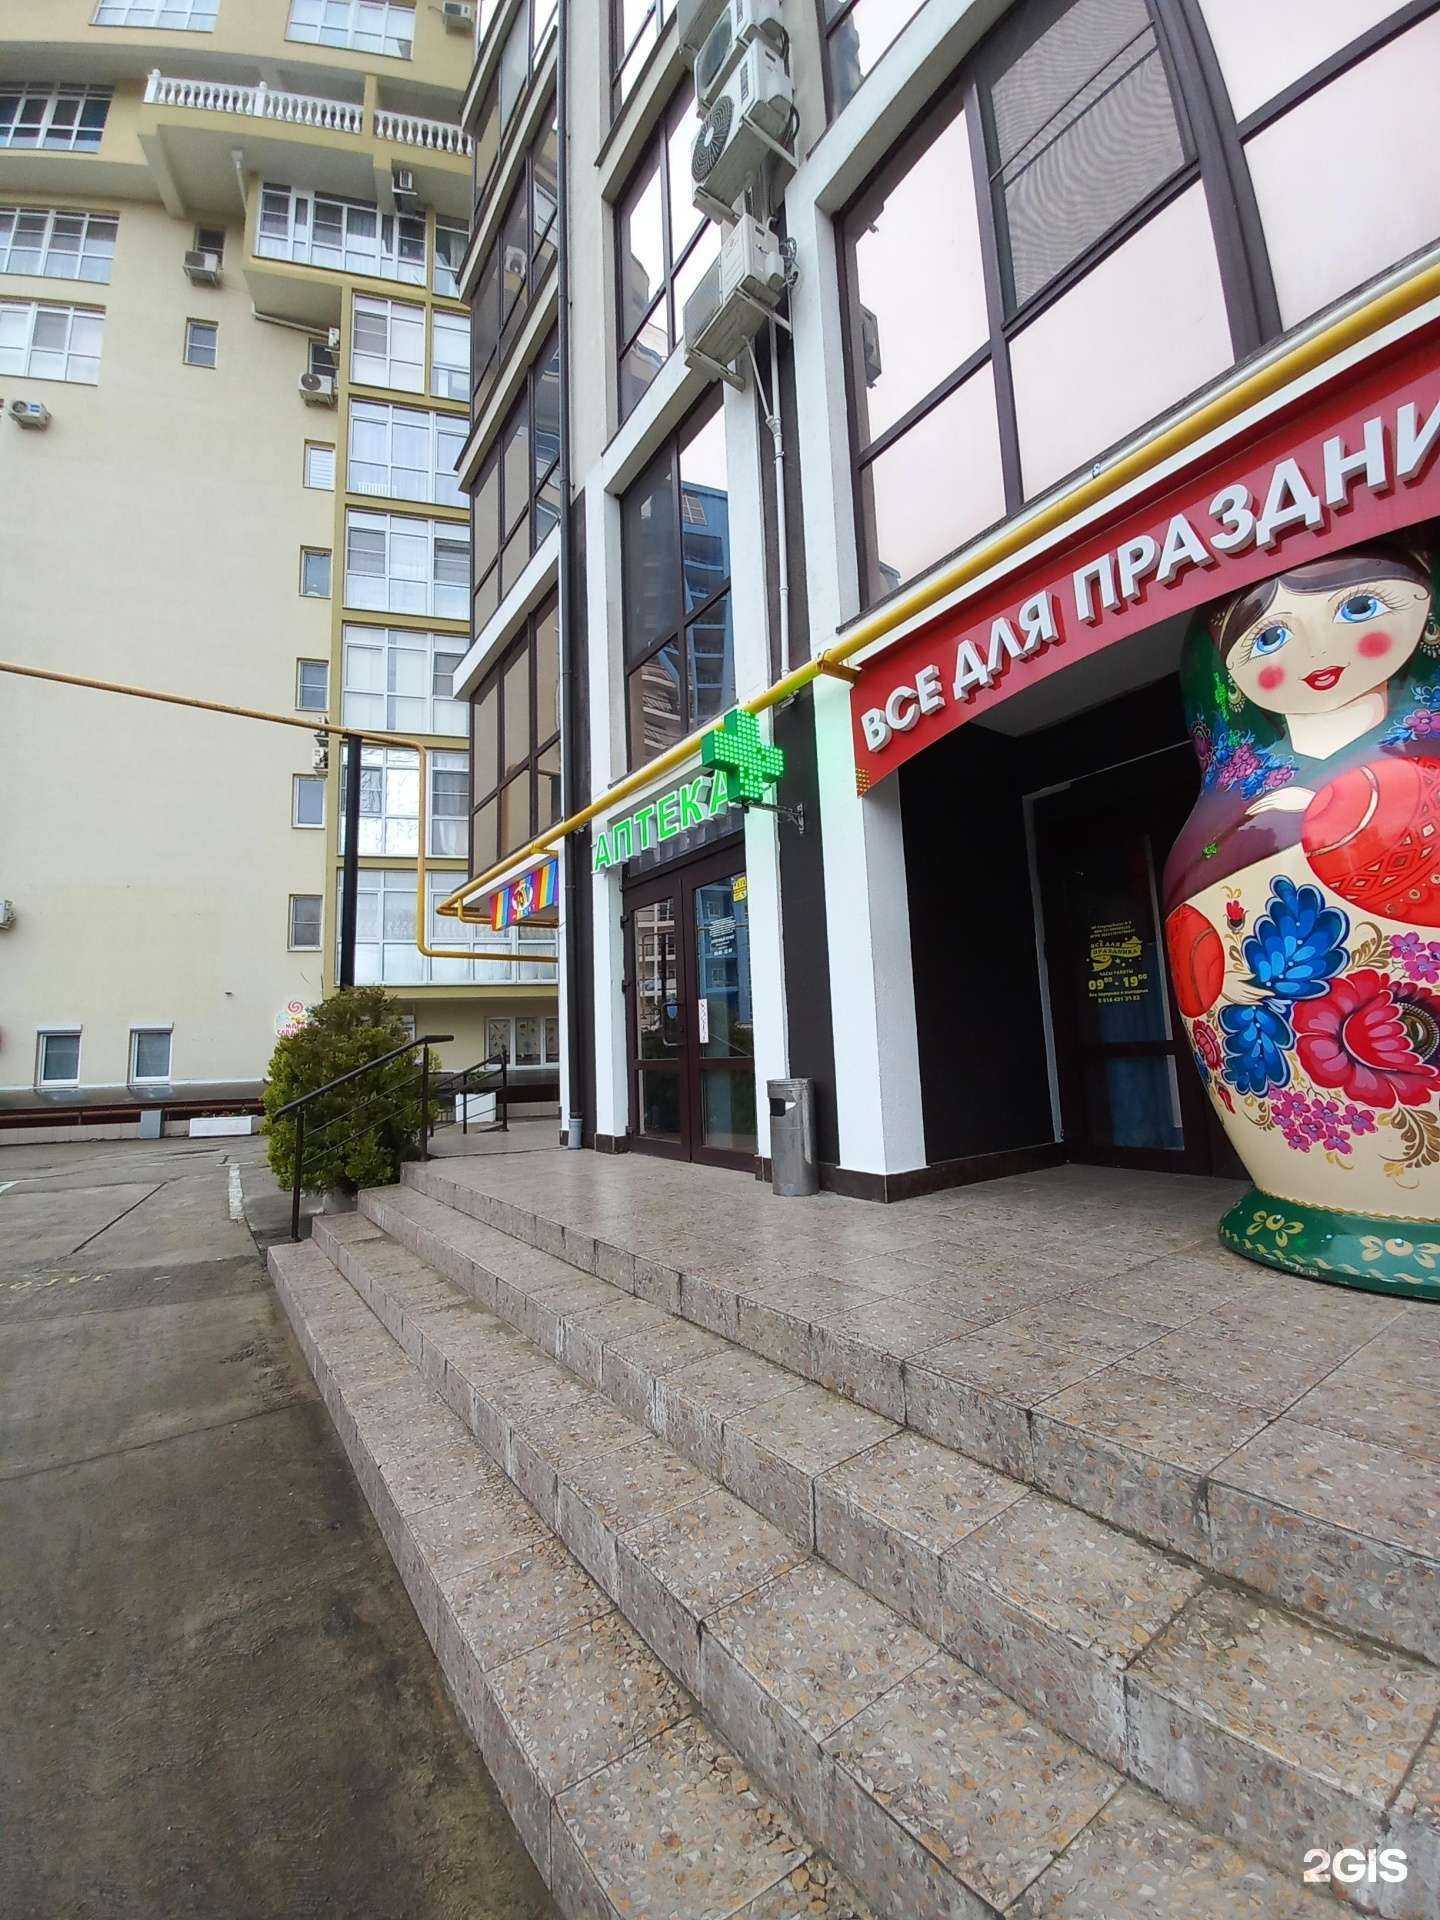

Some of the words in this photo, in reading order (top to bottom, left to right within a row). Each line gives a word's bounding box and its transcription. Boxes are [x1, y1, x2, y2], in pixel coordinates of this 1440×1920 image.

[861, 664, 946, 752] ВСЕ
[953, 590, 1059, 702] ДЛЯ
[592, 769, 729, 873] АПТЕКА
